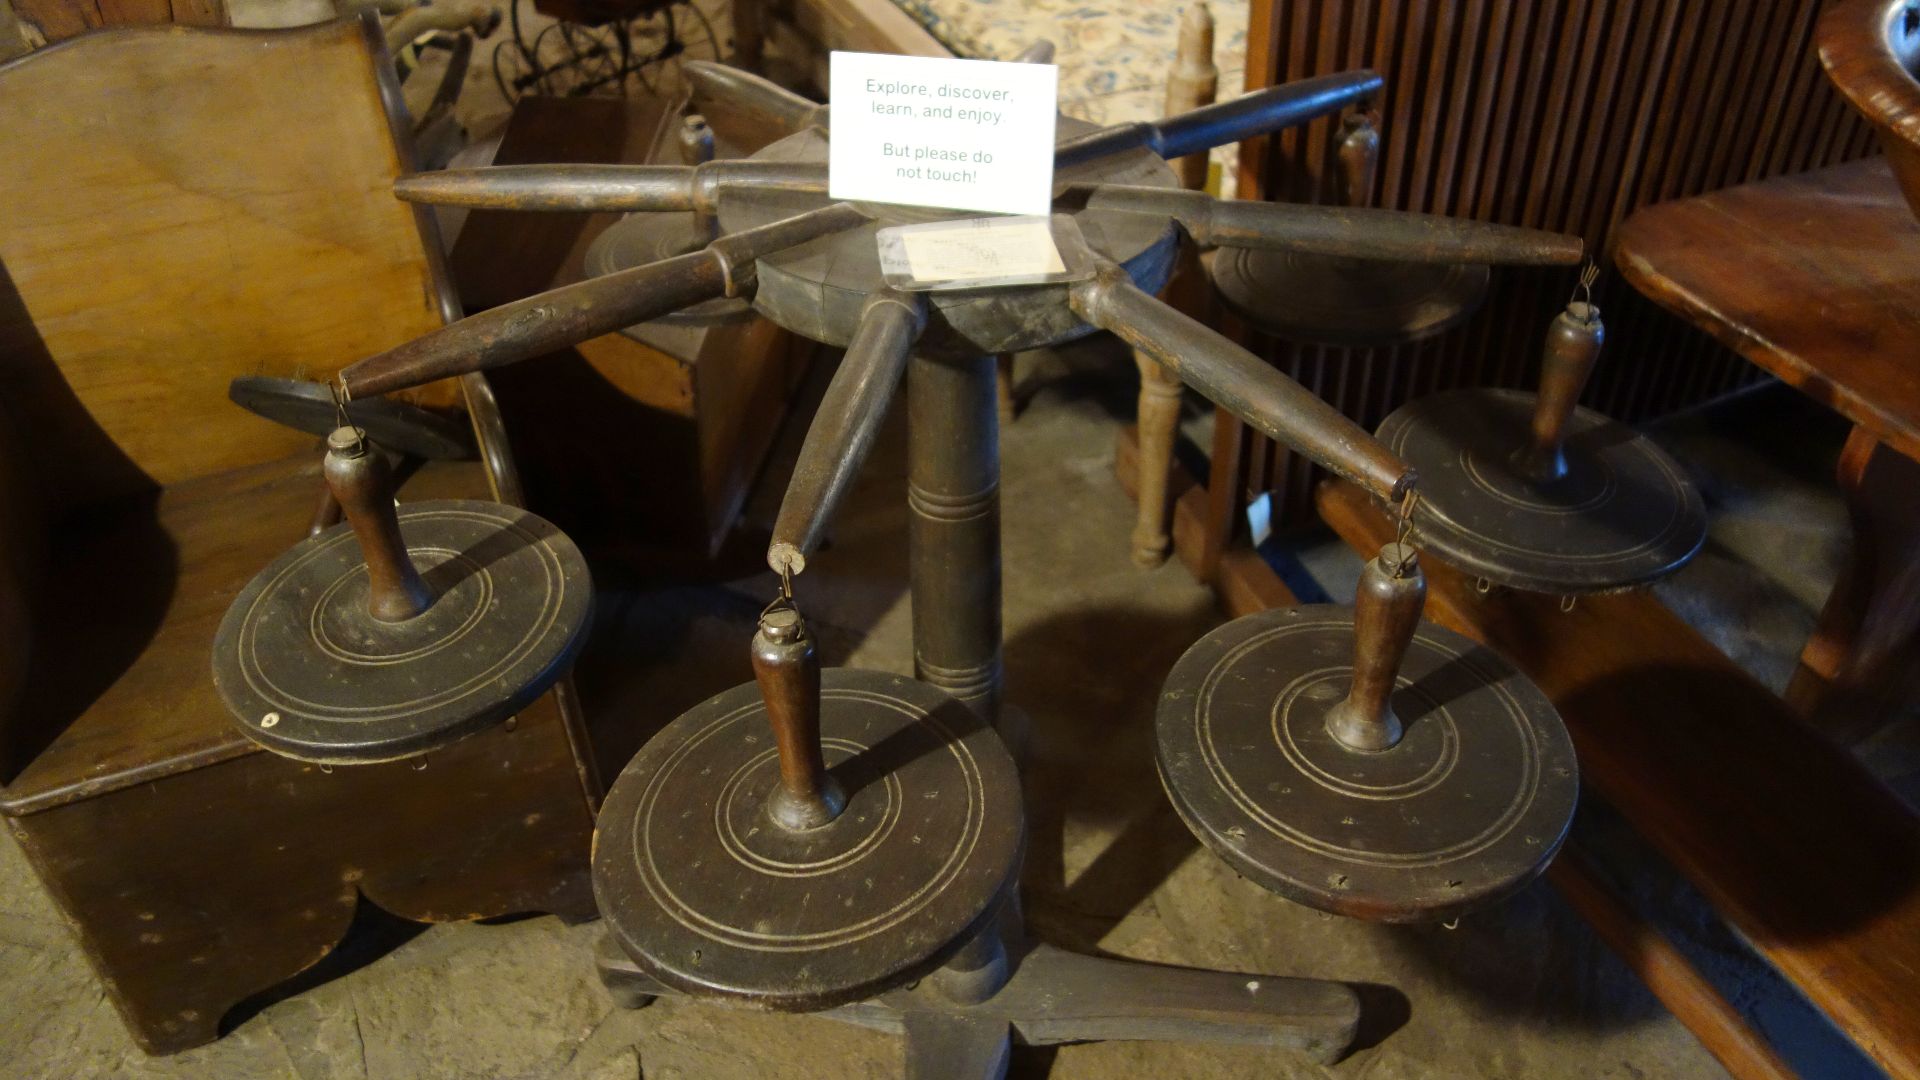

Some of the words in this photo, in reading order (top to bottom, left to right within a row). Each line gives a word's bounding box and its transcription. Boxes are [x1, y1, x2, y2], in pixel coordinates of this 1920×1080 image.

[866, 78, 933, 98] Explore,
[937, 83, 1014, 103] discover,
[871, 100, 917, 118] learn,
[922, 105, 953, 119] and
[957, 108, 1006, 126] enjoy.
[883, 142, 910, 158] But
[915, 146, 968, 162] please
[973, 150, 993, 164] do
[896, 166, 921, 180] not
[927, 166, 977, 184] touch!
